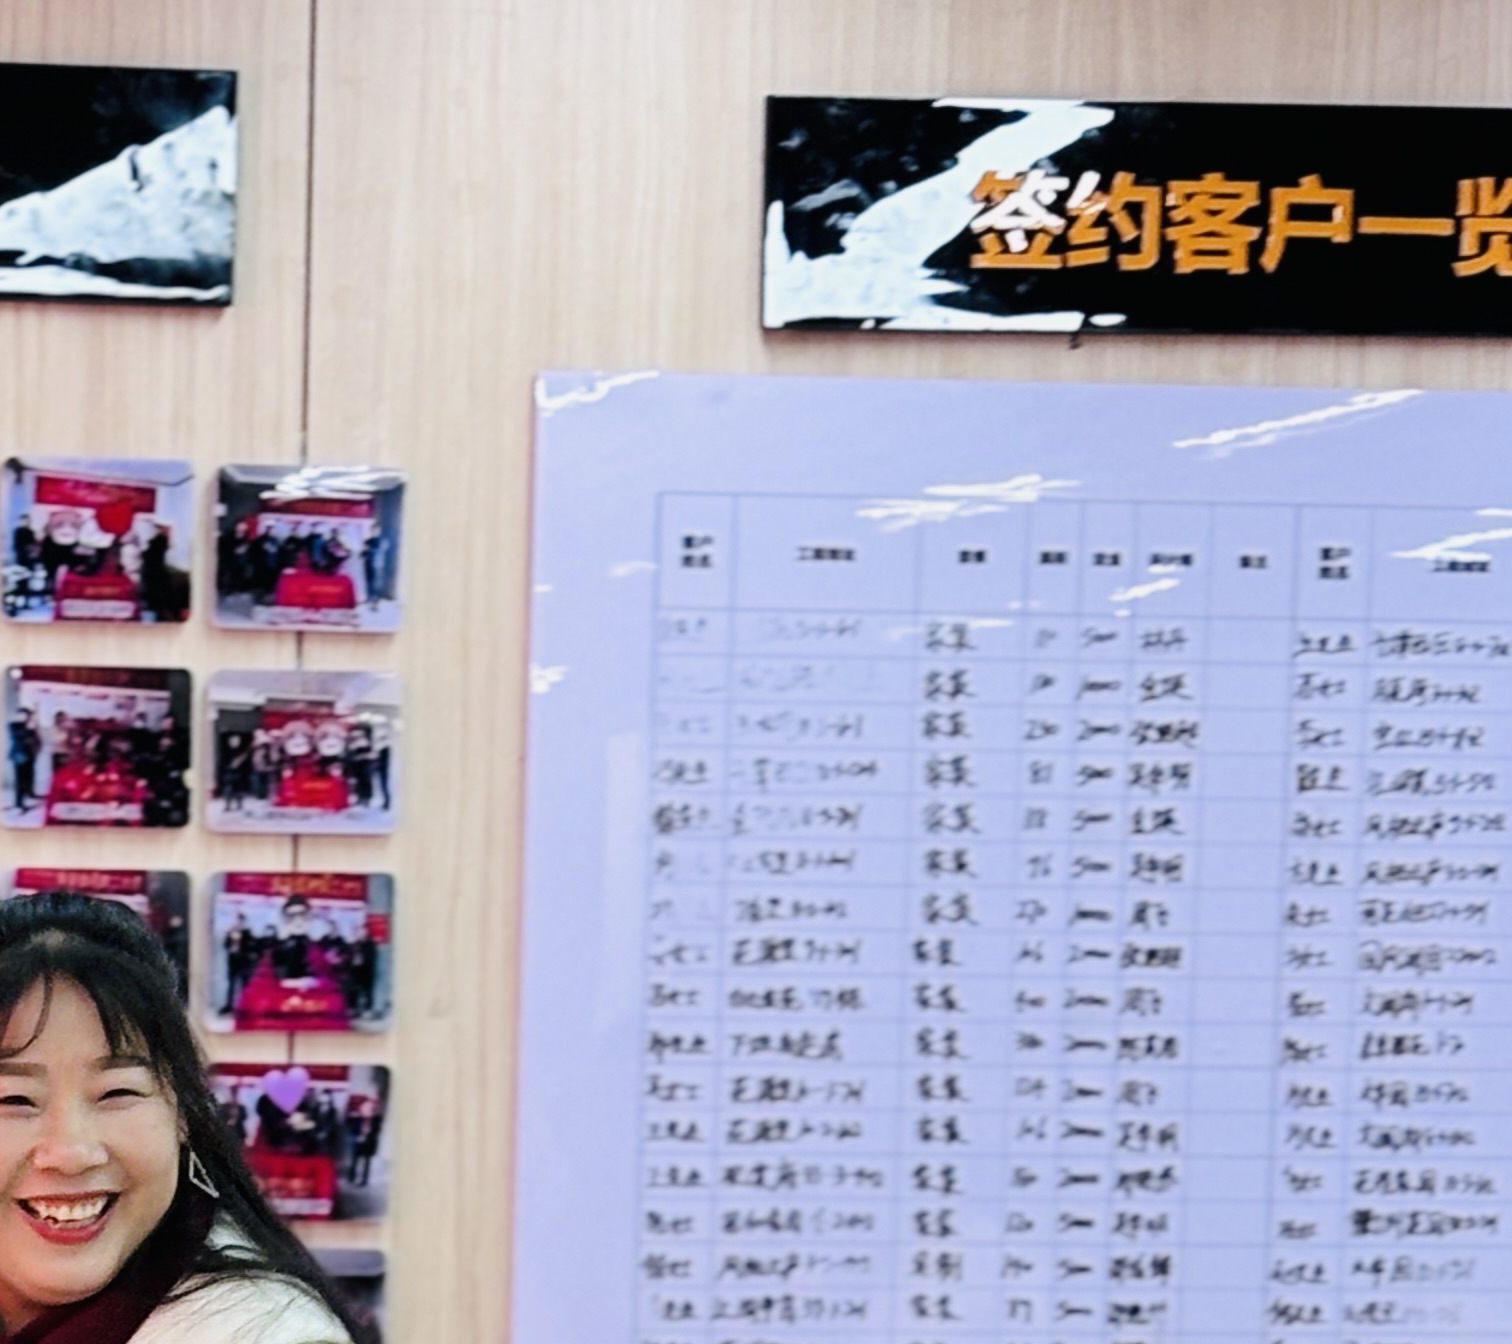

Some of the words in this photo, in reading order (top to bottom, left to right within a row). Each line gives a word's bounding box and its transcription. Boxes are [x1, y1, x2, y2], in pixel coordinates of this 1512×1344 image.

[969, 169, 1512, 277] 签约客户一览
